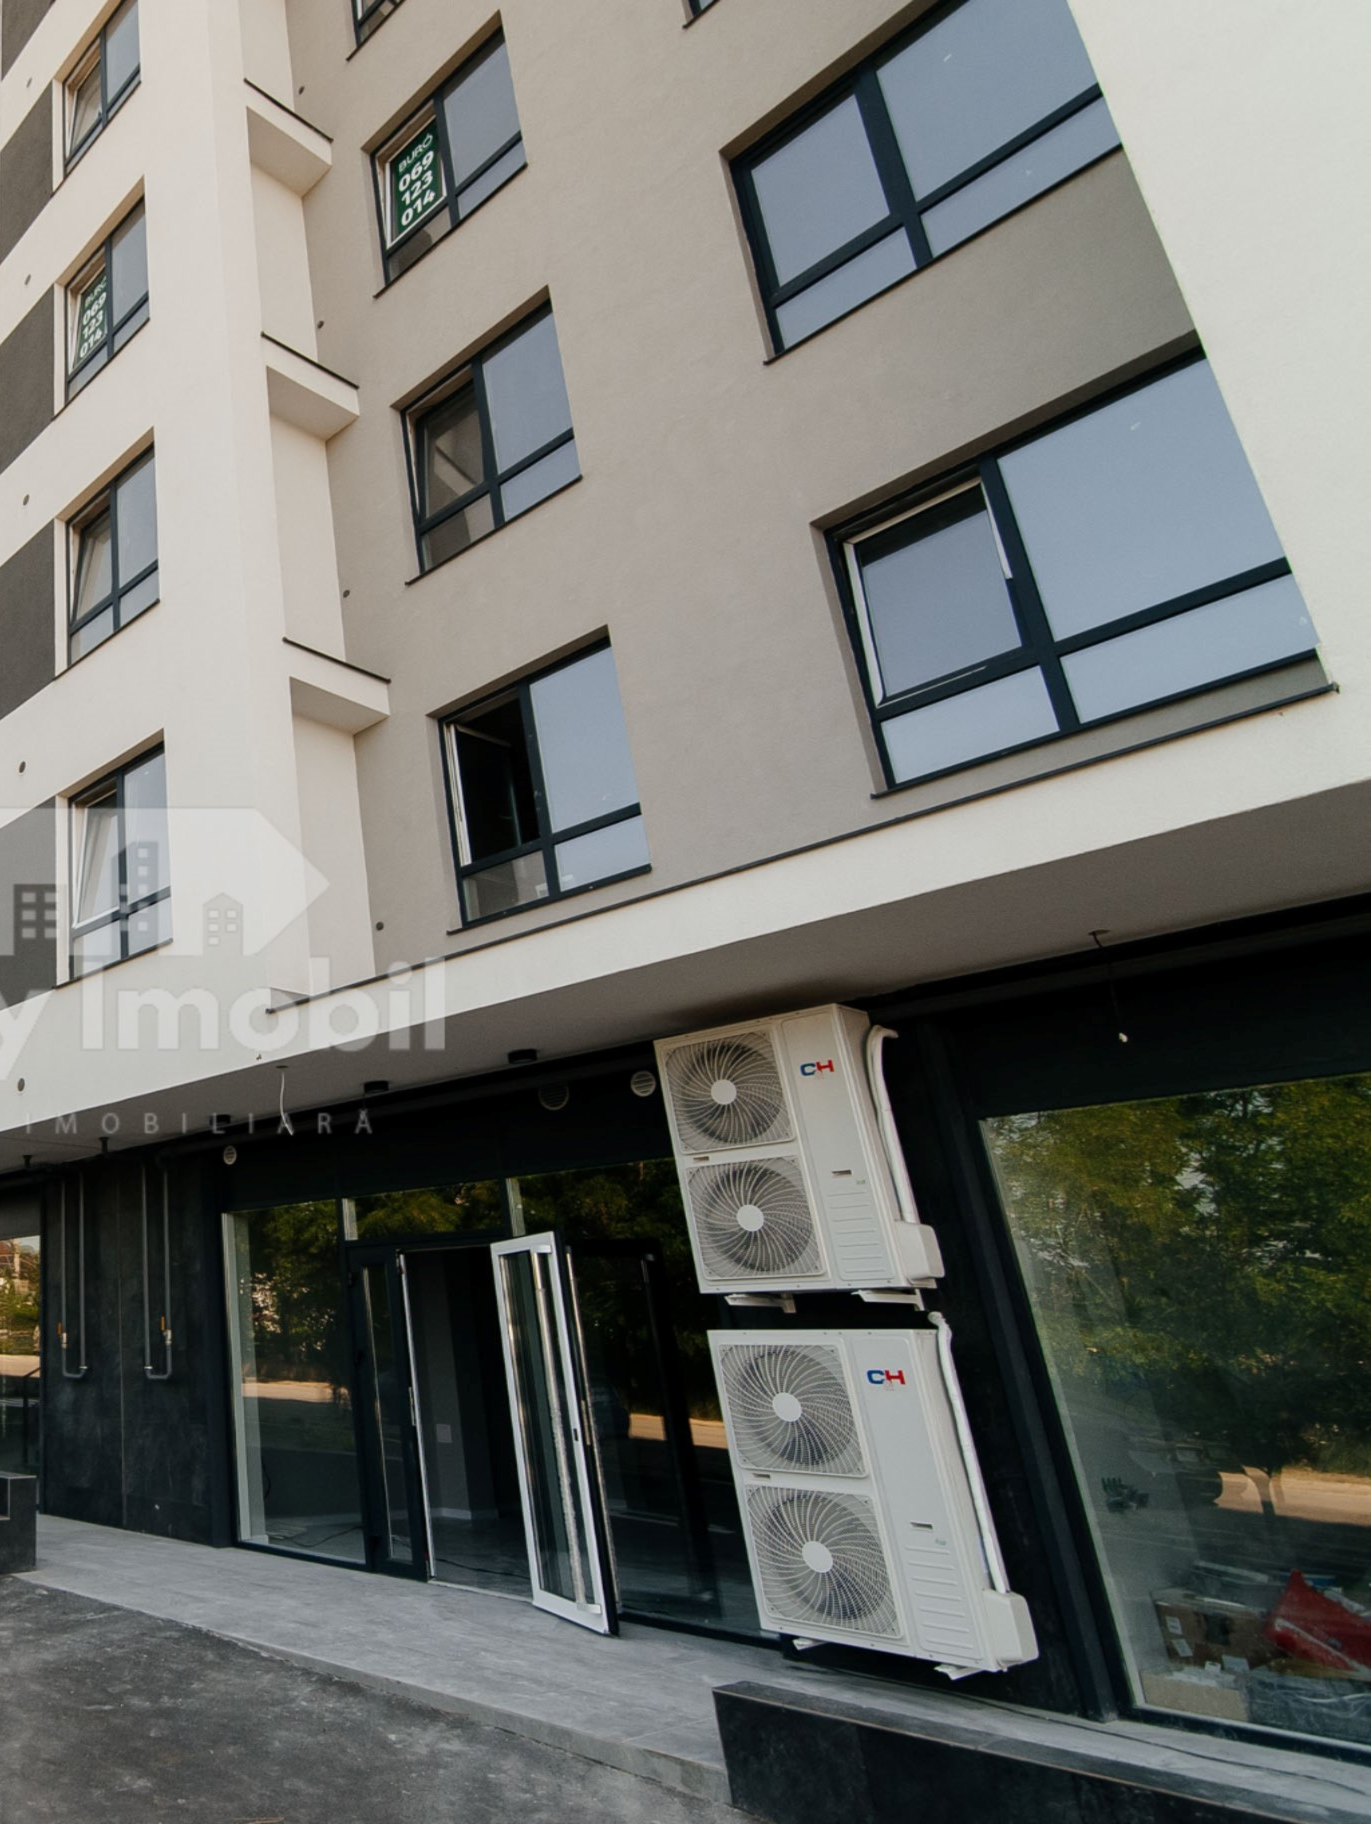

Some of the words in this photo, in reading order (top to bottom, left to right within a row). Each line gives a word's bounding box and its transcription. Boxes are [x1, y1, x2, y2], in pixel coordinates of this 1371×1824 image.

[398, 151, 434, 191] 069
[401, 170, 433, 206] 123
[401, 191, 435, 226] 014
[82, 310, 103, 339] 123
[83, 291, 107, 326] 069
[80, 328, 102, 358] 014
[800, 1059, 835, 1077] CH
[866, 1369, 906, 1385] CH
